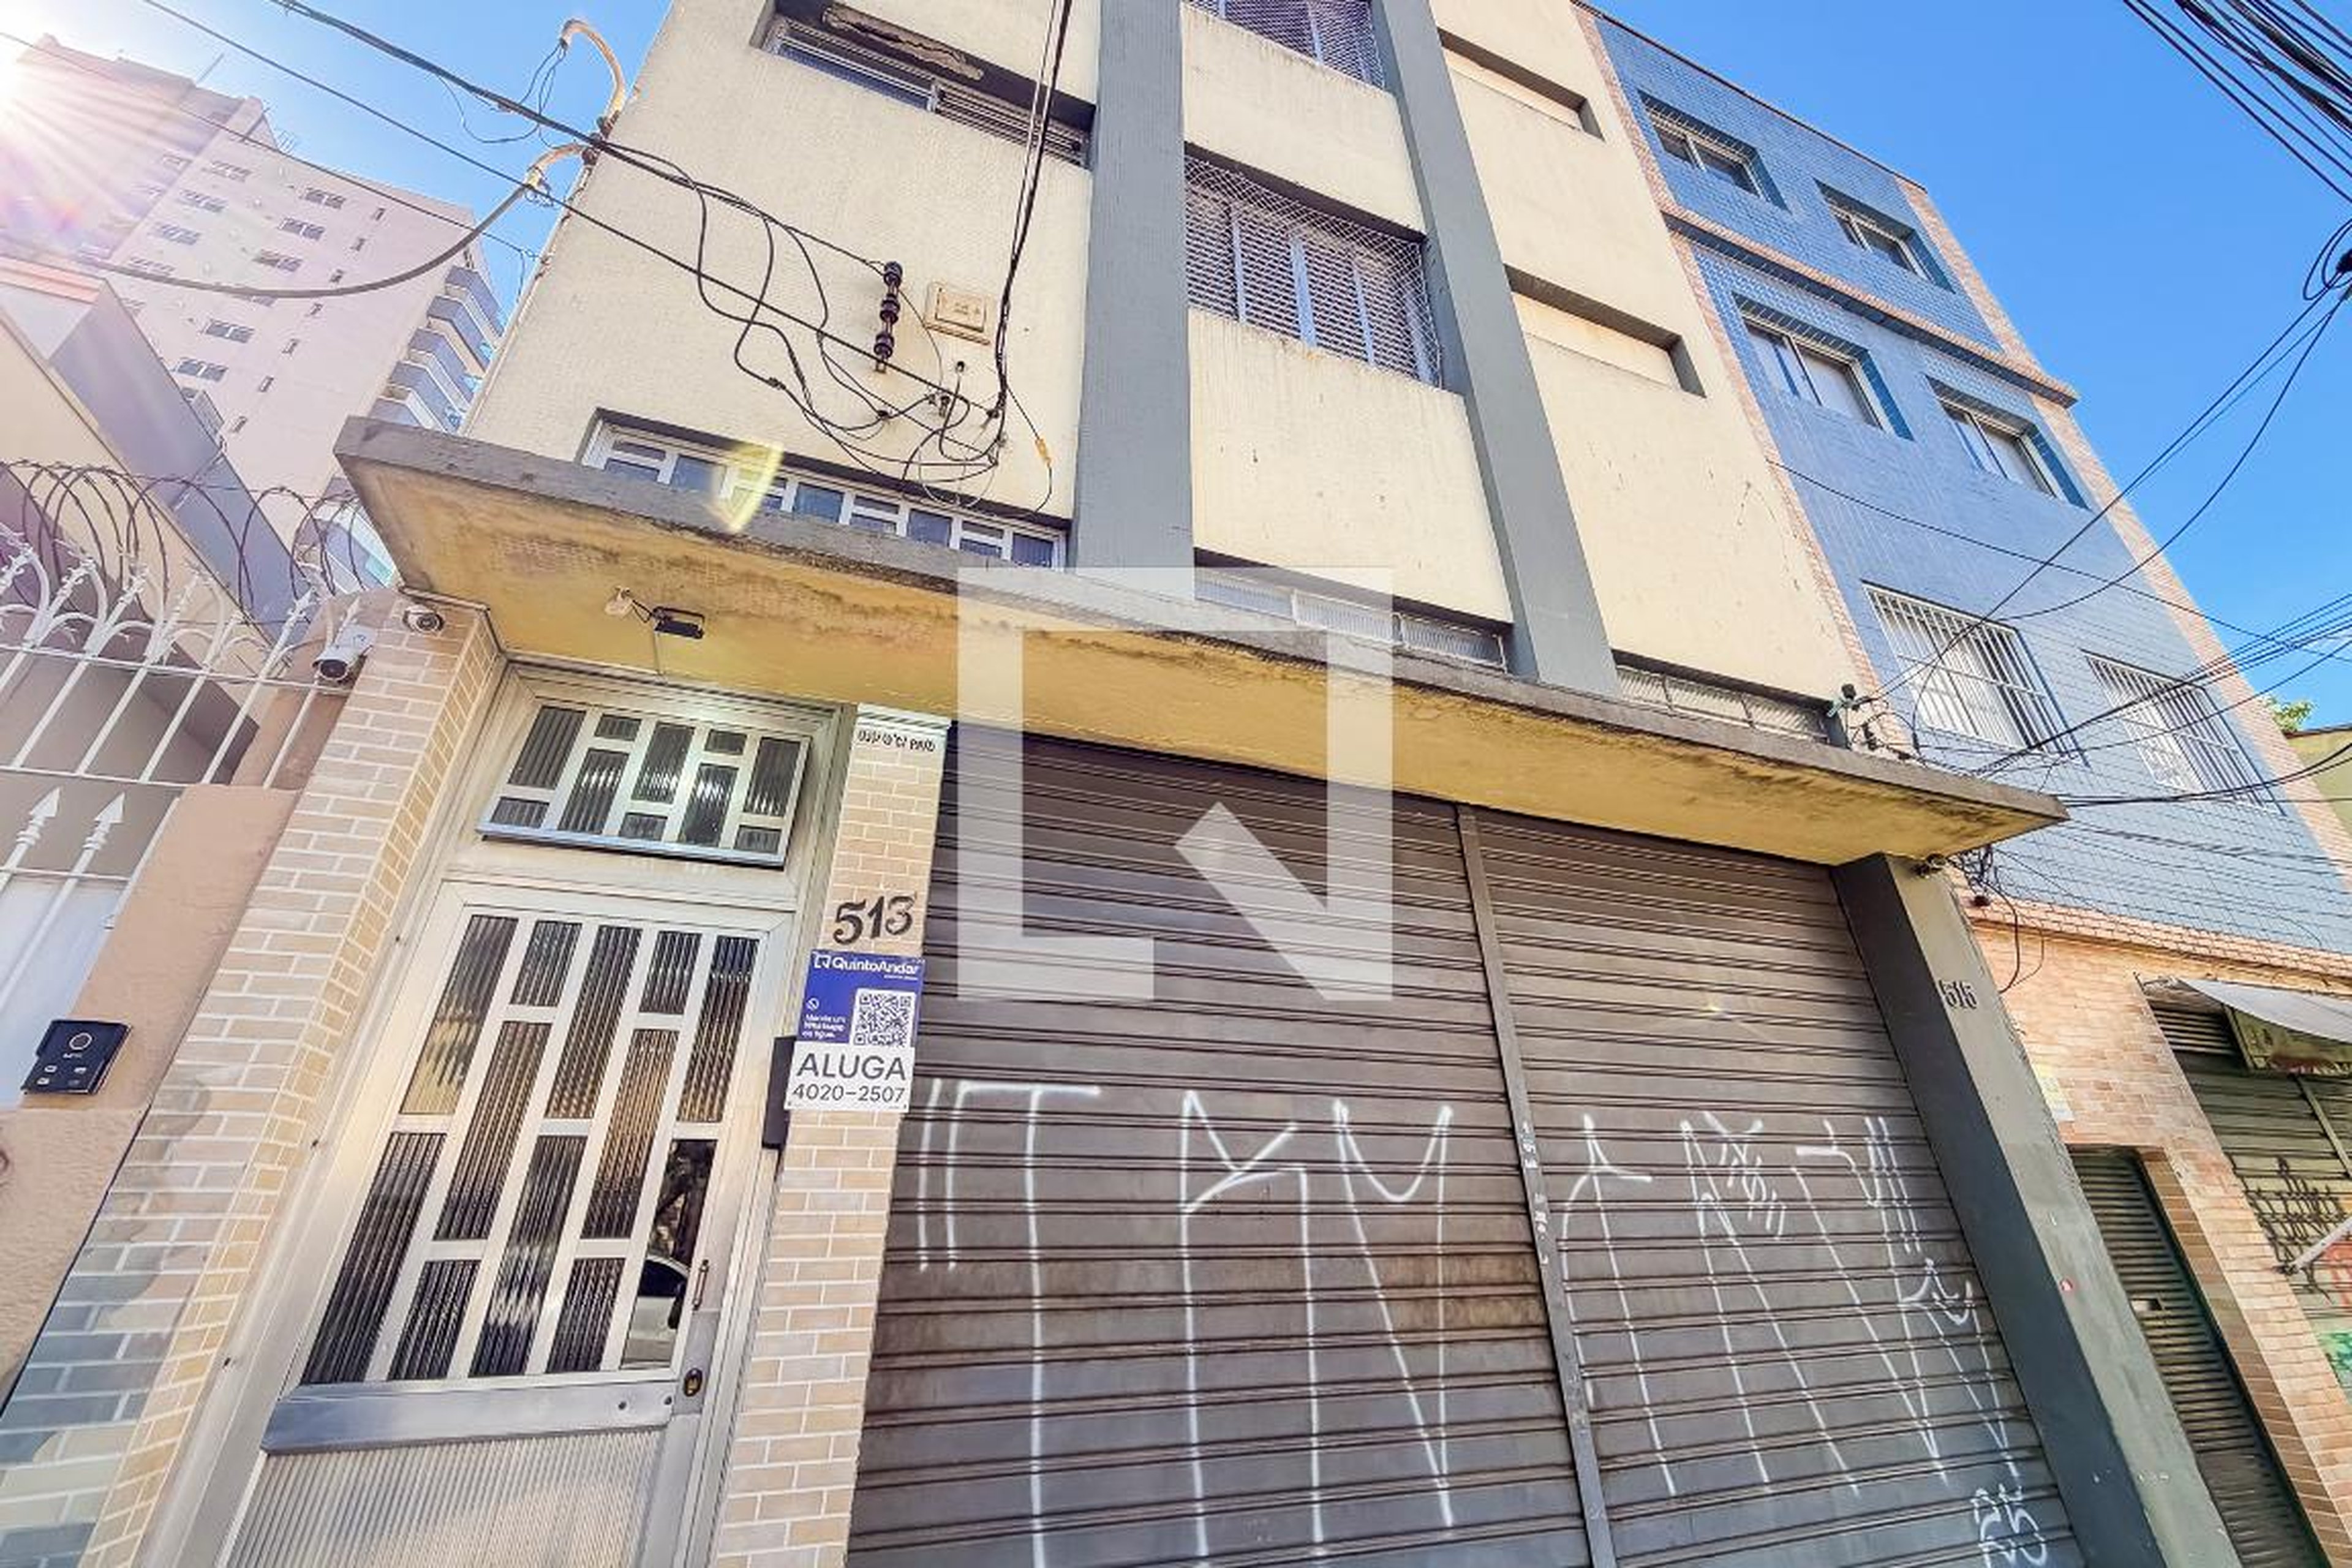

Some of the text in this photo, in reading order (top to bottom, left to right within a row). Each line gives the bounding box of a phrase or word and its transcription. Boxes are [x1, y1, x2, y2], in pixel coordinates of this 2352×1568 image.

[833, 895, 916, 944] 513
[832, 956, 919, 974] QuintoAndar
[797, 1053, 906, 1080] ALUGA
[792, 1083, 905, 1103] 4020-2507
